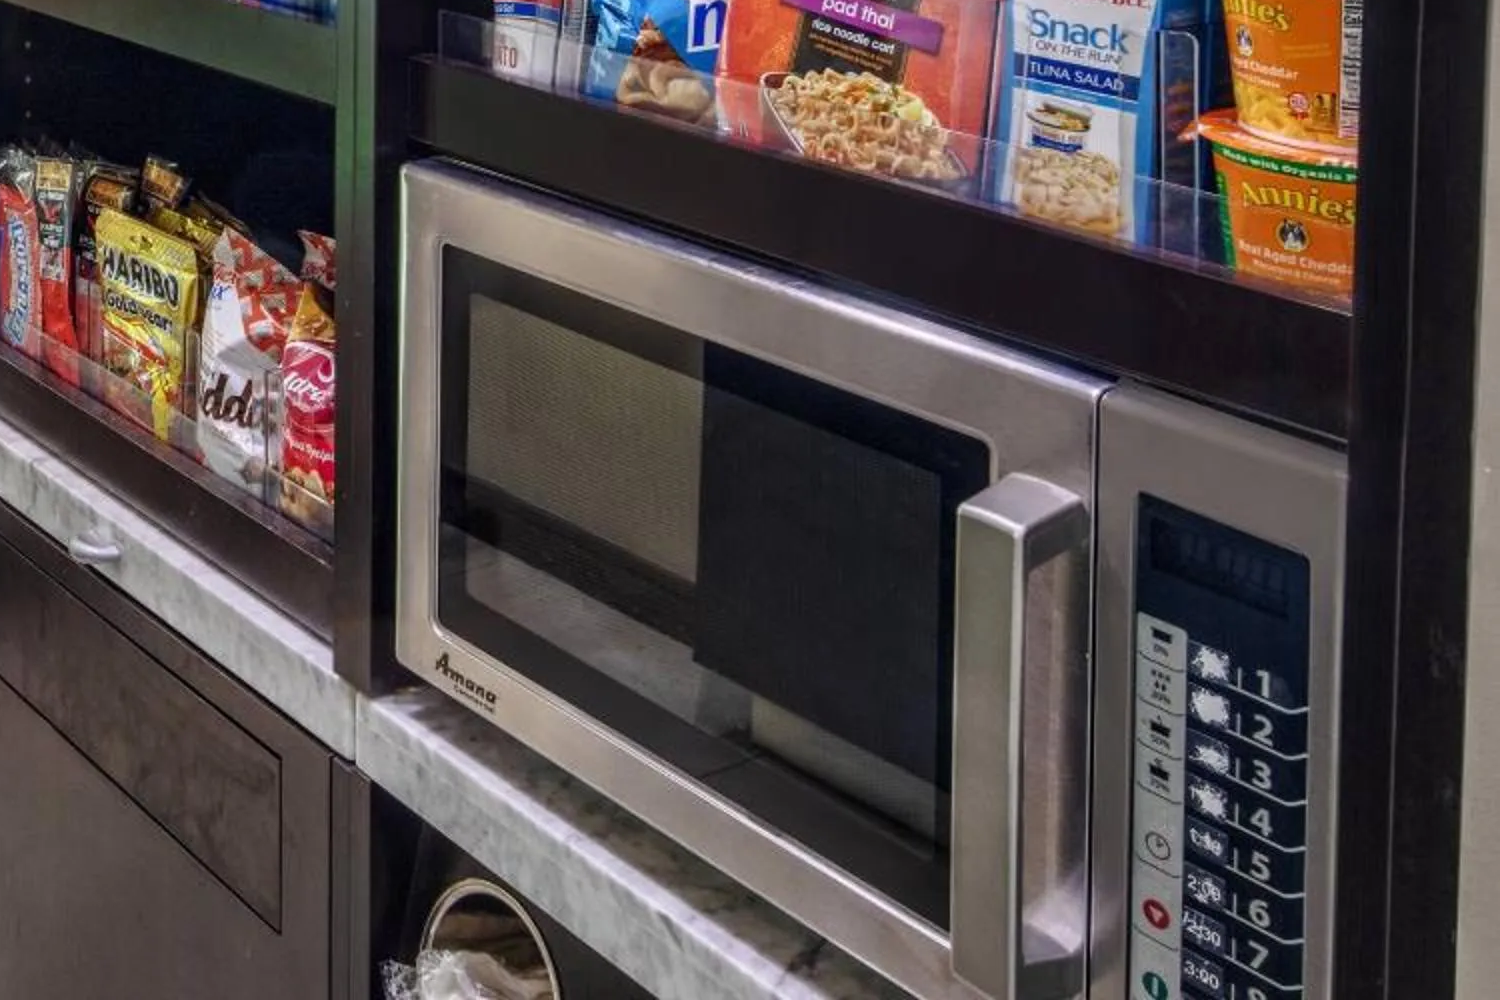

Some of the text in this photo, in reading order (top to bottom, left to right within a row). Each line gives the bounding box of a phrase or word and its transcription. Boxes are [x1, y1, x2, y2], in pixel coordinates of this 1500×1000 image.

[861, 5, 896, 31] thai
[1029, 8, 1129, 55] Snack
[833, 26, 870, 47] noodle
[1029, 60, 1126, 93] TUNA SALAD
[102, 246, 179, 308] HARIBO
[1298, 255, 1354, 276] Chedd
[435, 652, 497, 703] Amana
[1256, 669, 1270, 698] 1
[1252, 714, 1274, 747] 2
[1251, 759, 1272, 790] 3
[1250, 808, 1273, 837] 4
[1251, 850, 1271, 882] 5
[1248, 900, 1271, 929] 6
[1248, 940, 1269, 969] 7
